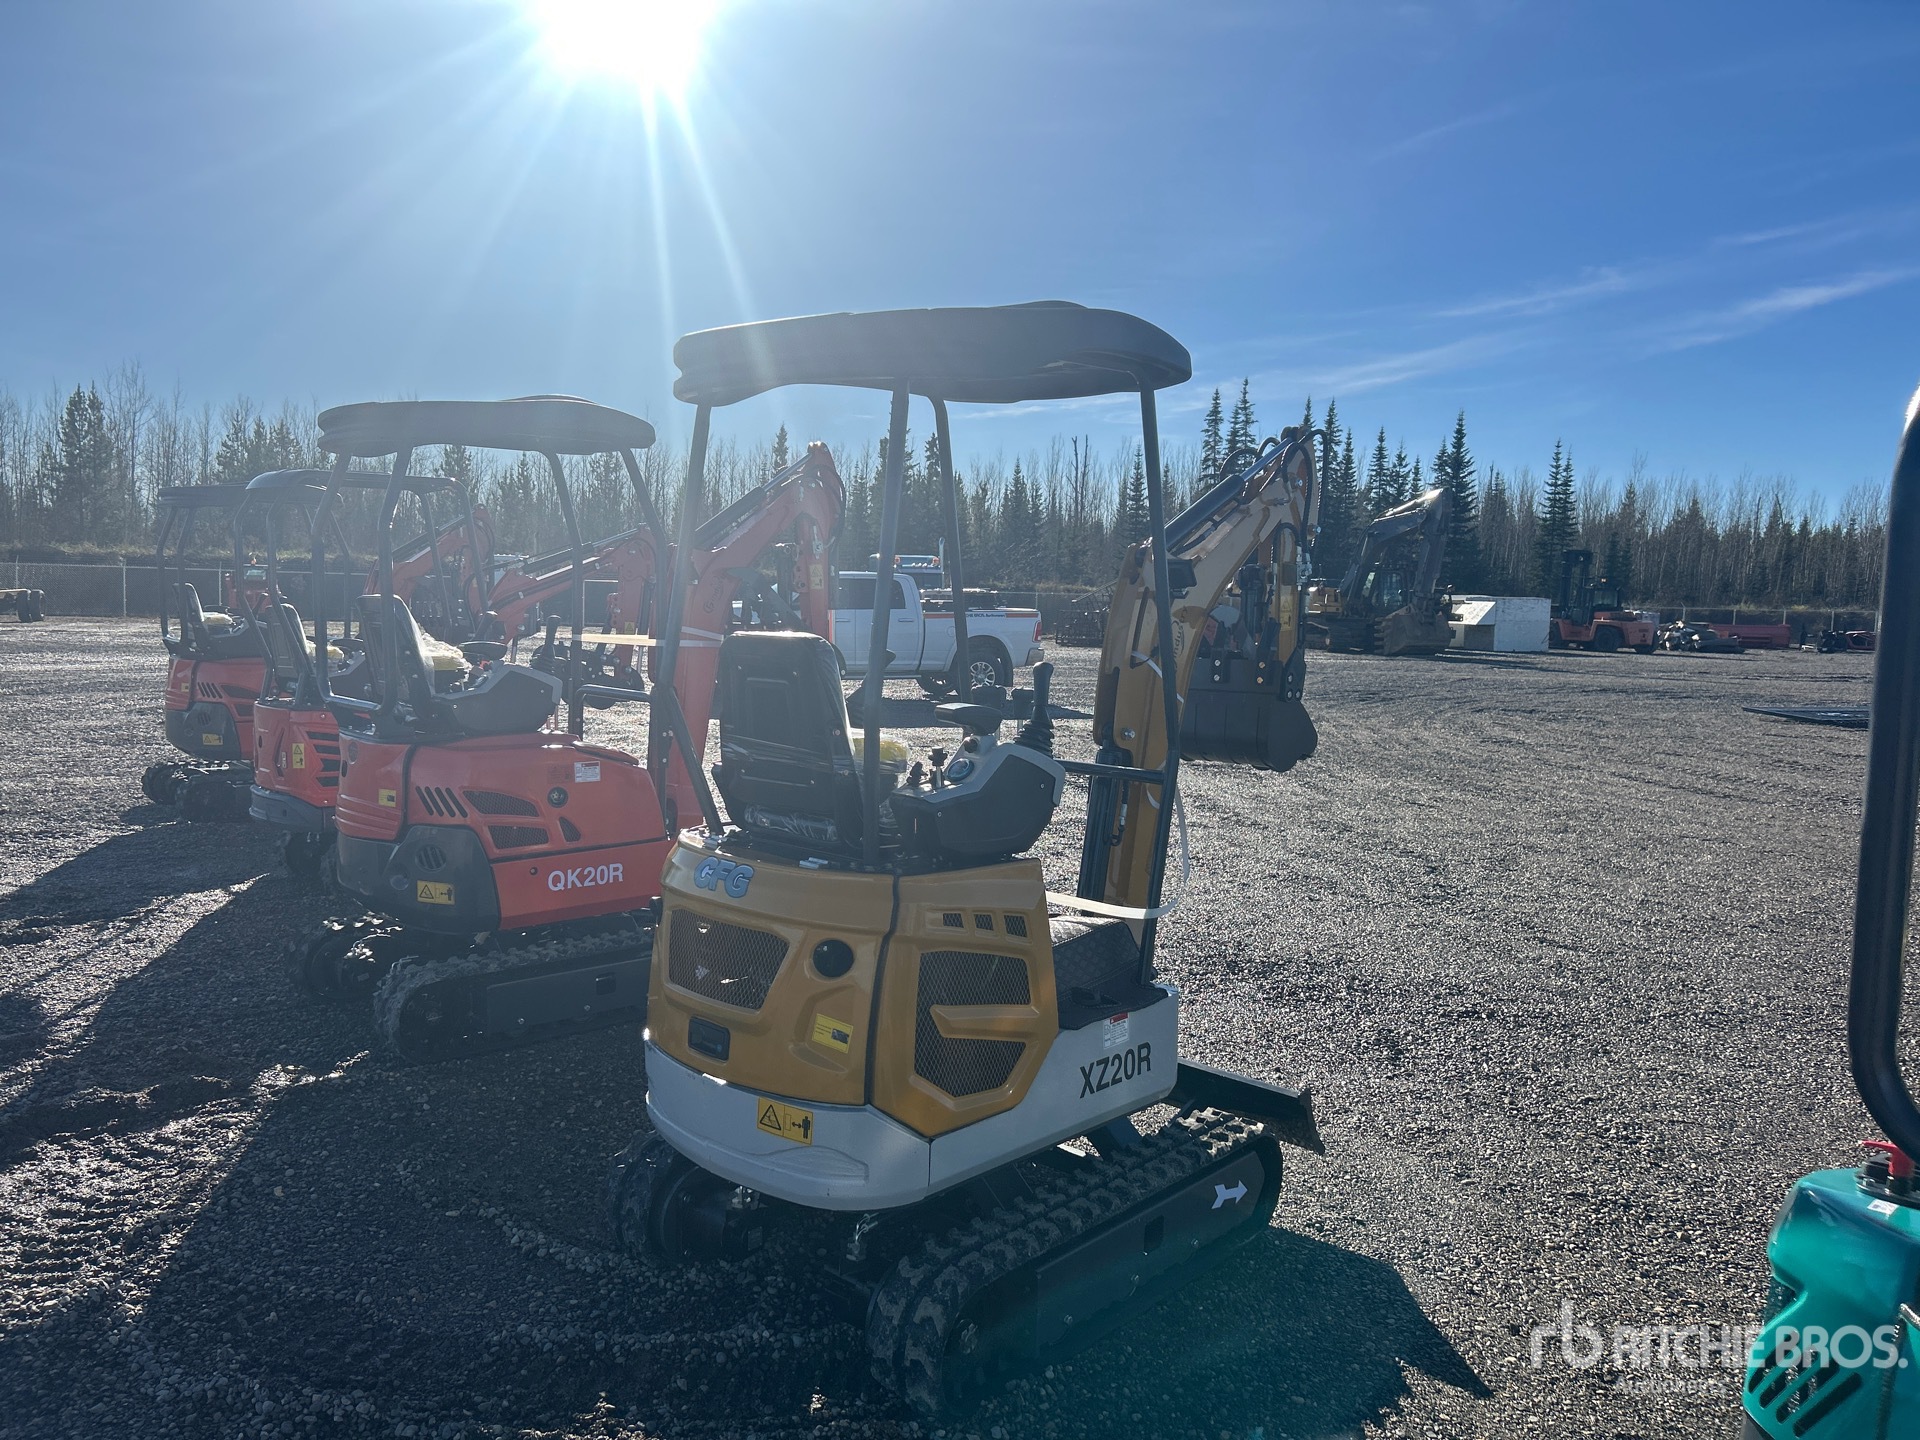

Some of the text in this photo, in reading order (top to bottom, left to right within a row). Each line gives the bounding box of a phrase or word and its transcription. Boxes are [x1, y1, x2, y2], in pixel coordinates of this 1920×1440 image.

[548, 863, 623, 891] QK20R
[694, 856, 754, 898] CFG
[1080, 1042, 1151, 1099] XZ20R
